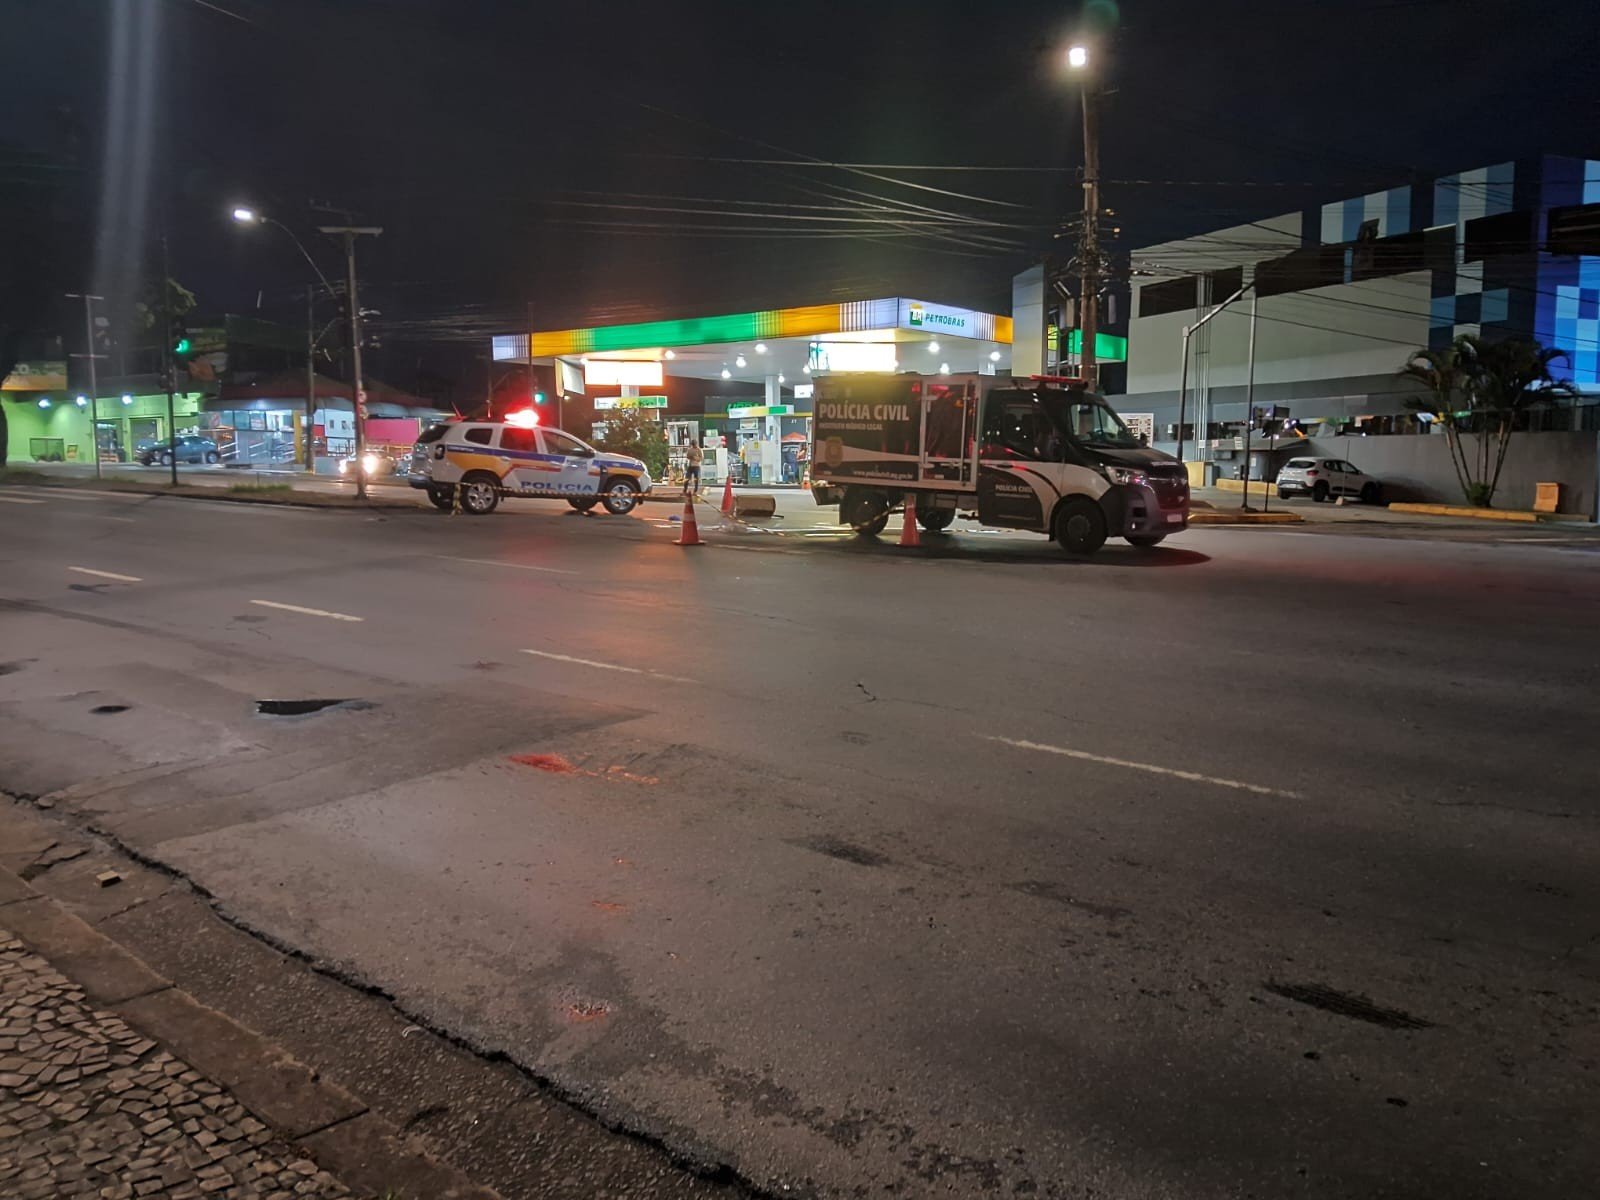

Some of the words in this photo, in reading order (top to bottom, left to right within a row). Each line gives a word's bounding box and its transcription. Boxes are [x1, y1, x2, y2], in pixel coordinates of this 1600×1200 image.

[925, 313, 965, 327] PETROBRAS
[819, 400, 871, 420] POLÍCIA
[873, 404, 910, 421] CIVIL
